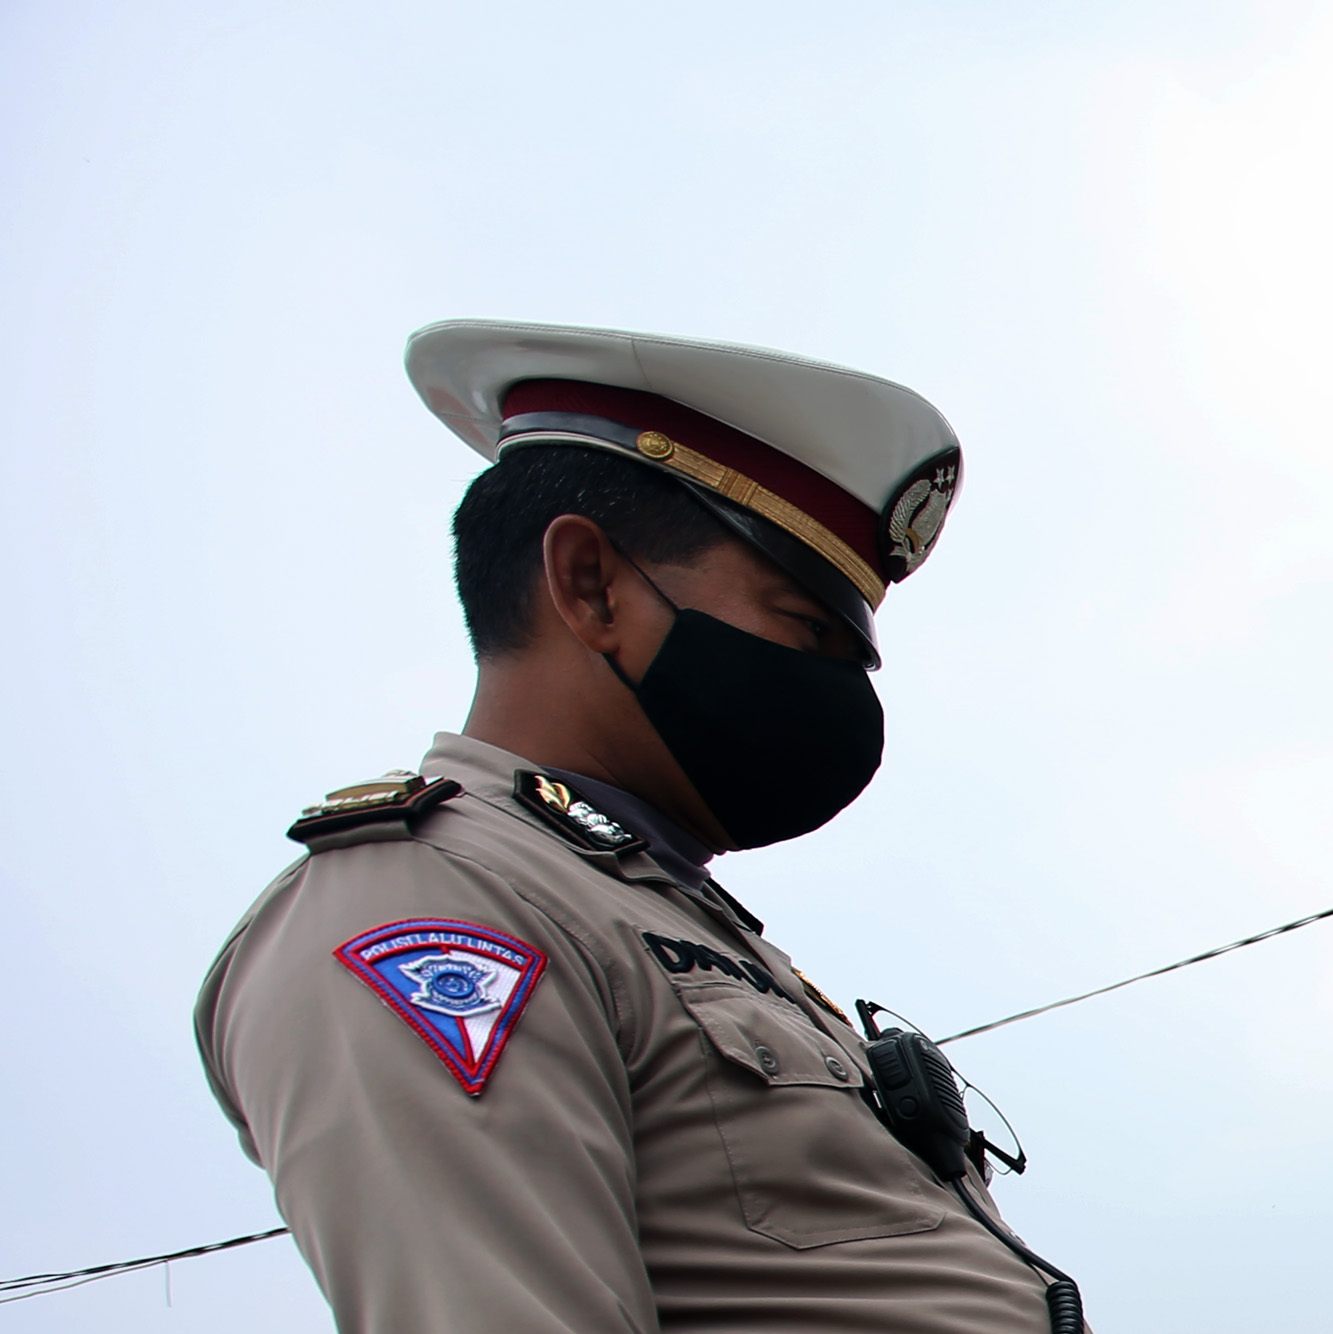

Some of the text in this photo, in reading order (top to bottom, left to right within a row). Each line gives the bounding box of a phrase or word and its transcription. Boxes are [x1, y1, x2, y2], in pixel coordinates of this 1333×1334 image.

[360, 932, 524, 965] POLISI LALU LINTAS
